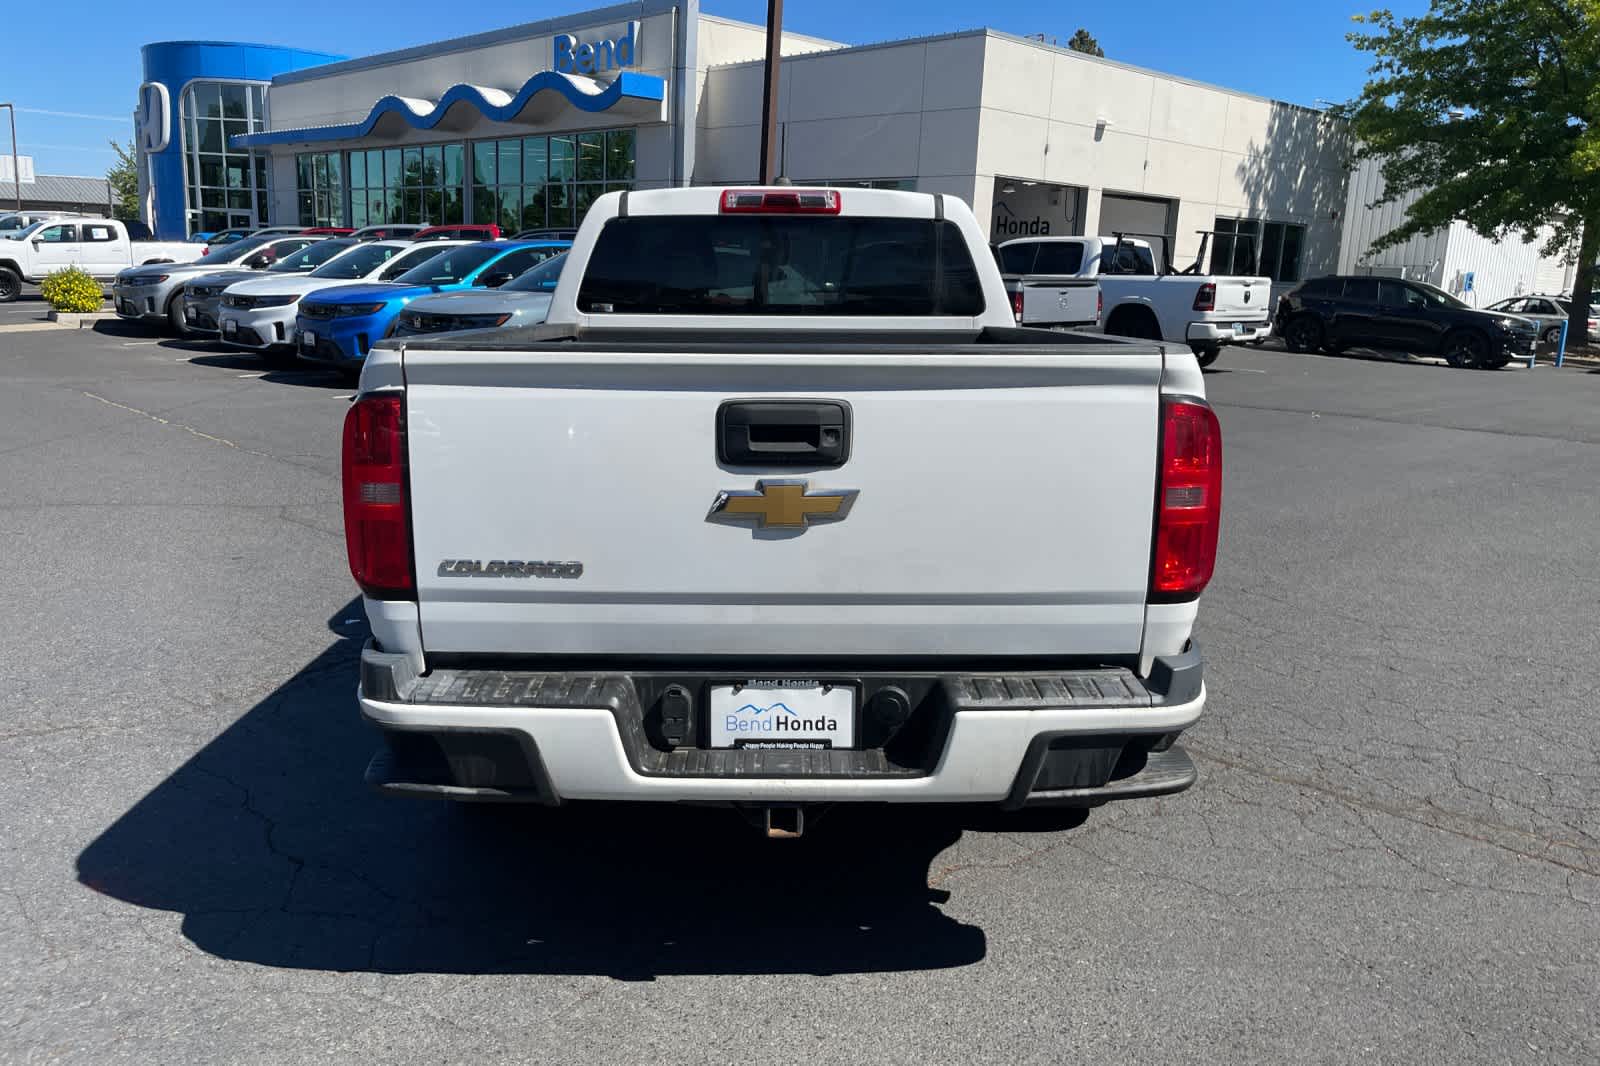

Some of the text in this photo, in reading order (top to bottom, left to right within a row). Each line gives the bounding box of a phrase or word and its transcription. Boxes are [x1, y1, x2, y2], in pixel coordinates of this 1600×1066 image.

[553, 21, 640, 74] Bend
[996, 215, 1050, 235] Honda
[437, 559, 584, 578] COLORADO
[747, 679, 819, 689] Bend Honda
[726, 715, 837, 732] Bend Honda
[760, 742, 776, 750] People
[776, 742, 793, 750] Making
[793, 742, 809, 750] People
